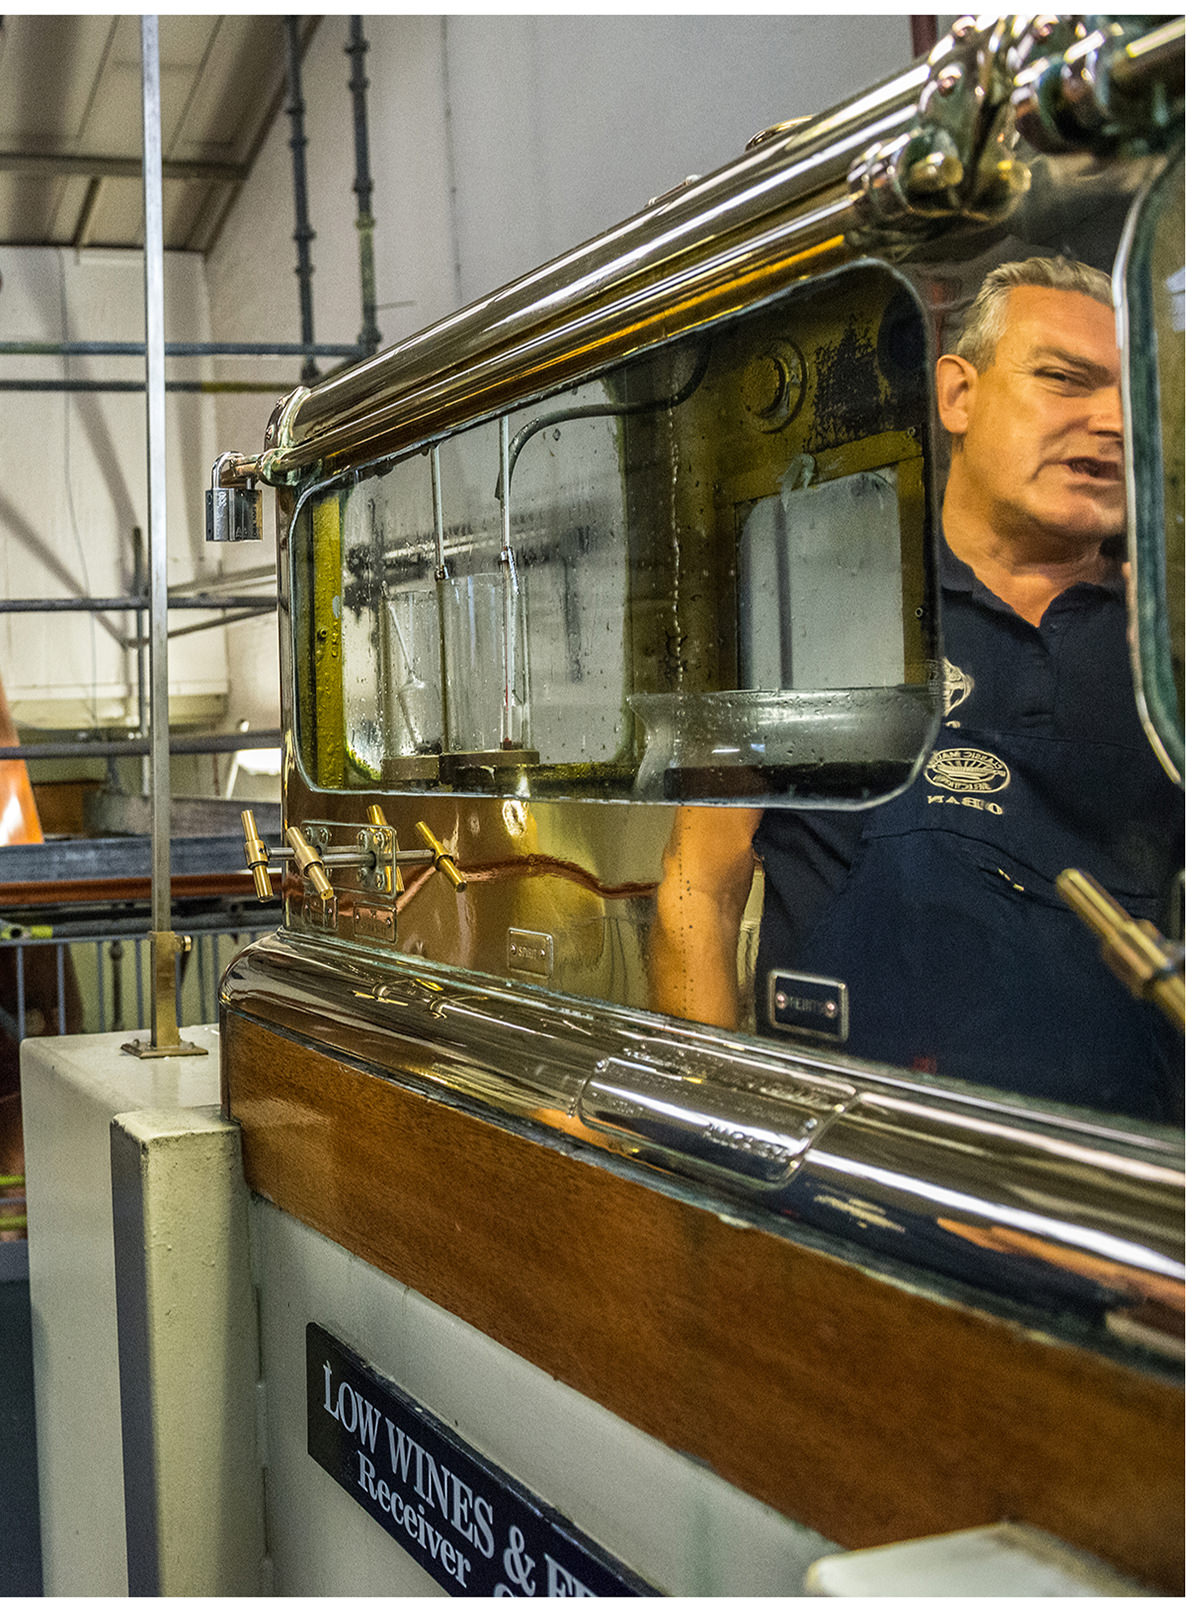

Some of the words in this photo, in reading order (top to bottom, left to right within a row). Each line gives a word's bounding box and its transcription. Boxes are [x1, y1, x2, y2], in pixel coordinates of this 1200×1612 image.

[323, 1362, 382, 1454] LOW
[385, 1417, 496, 1560] WINES
[503, 1525, 536, 1597] &
[357, 1450, 472, 1588] Receiver
